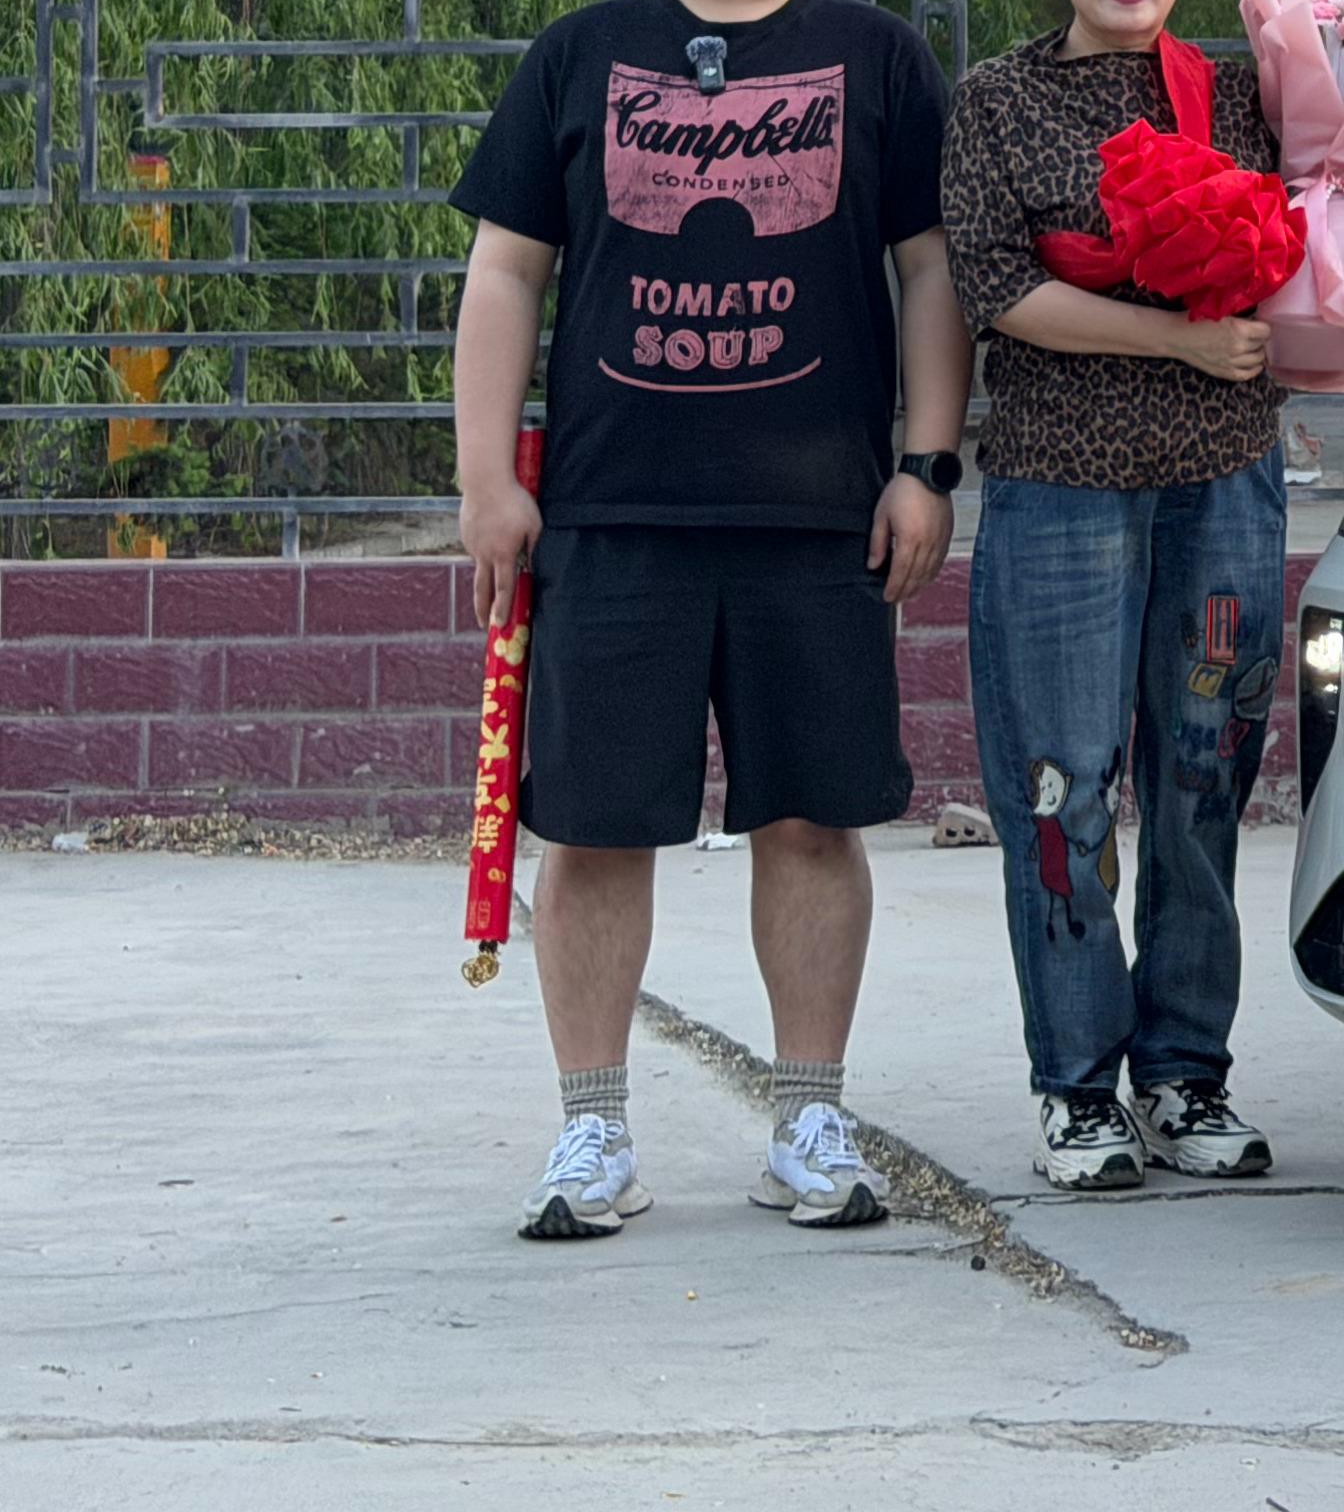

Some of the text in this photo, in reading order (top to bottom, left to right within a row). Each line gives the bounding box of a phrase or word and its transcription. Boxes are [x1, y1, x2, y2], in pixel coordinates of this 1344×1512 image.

[652, 172, 790, 191] CONDENSED
[630, 275, 795, 316] TOMATO
[632, 325, 784, 371] SOUP
